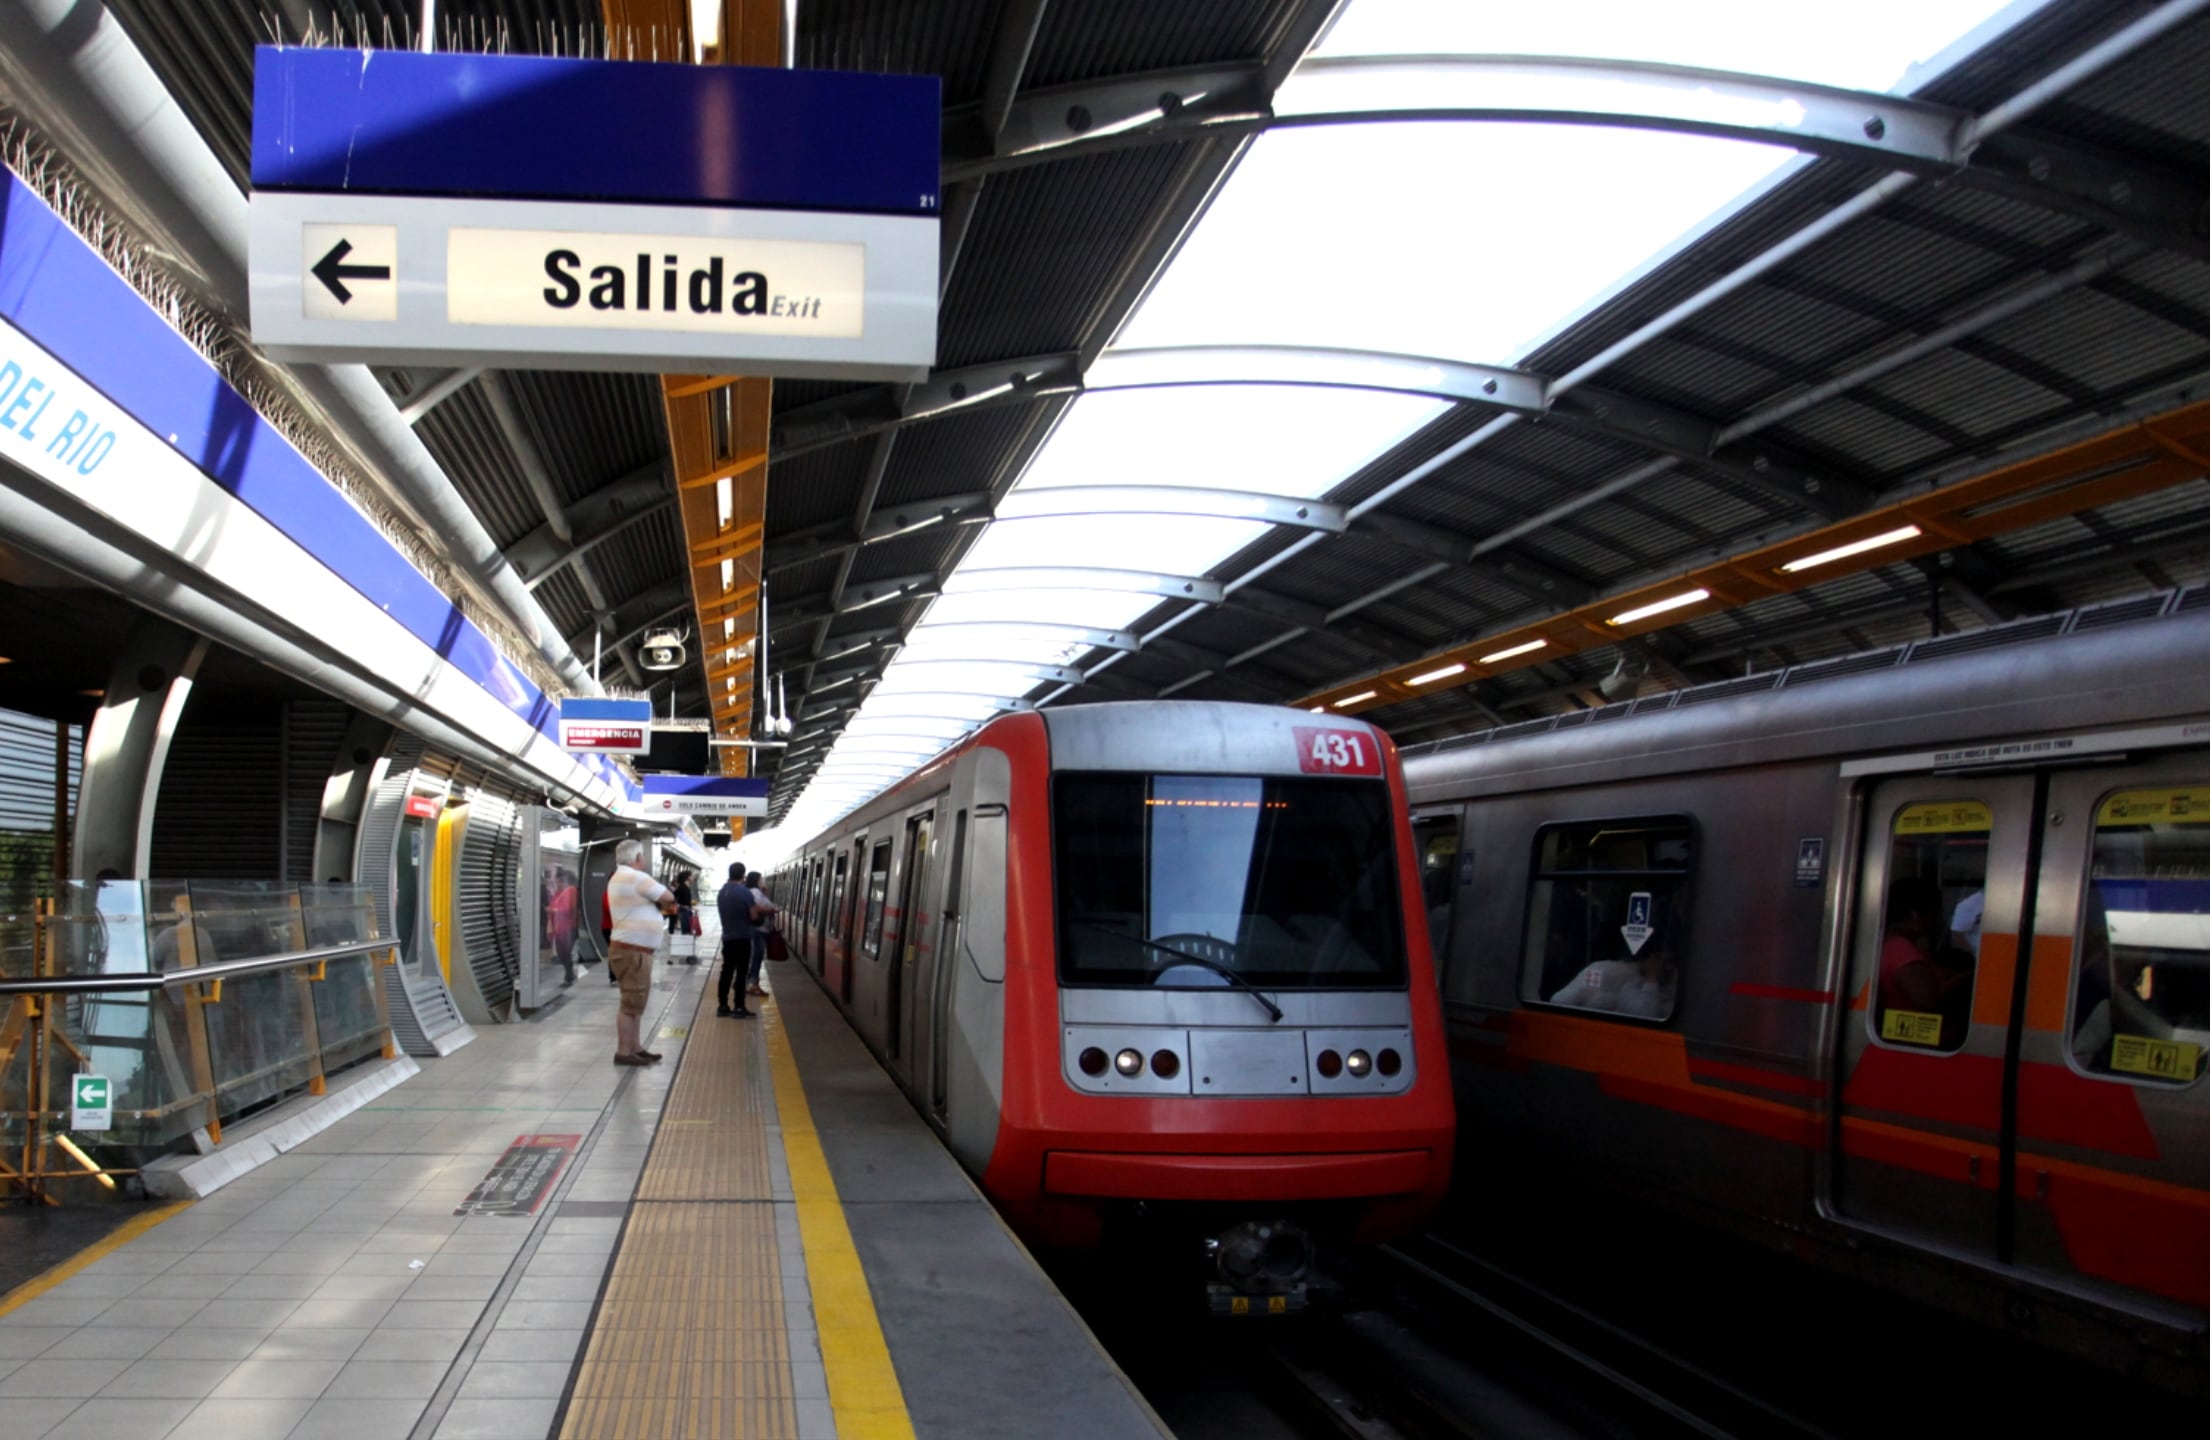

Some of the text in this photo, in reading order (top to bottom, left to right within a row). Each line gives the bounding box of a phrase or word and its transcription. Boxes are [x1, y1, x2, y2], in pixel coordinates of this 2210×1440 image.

[919, 193, 935, 208] 21
[543, 248, 822, 318] Salida Exit
[0, 359, 117, 476] DEL RIO
[568, 728, 640, 739] EMERGENCIA
[1312, 734, 1365, 768] 431
